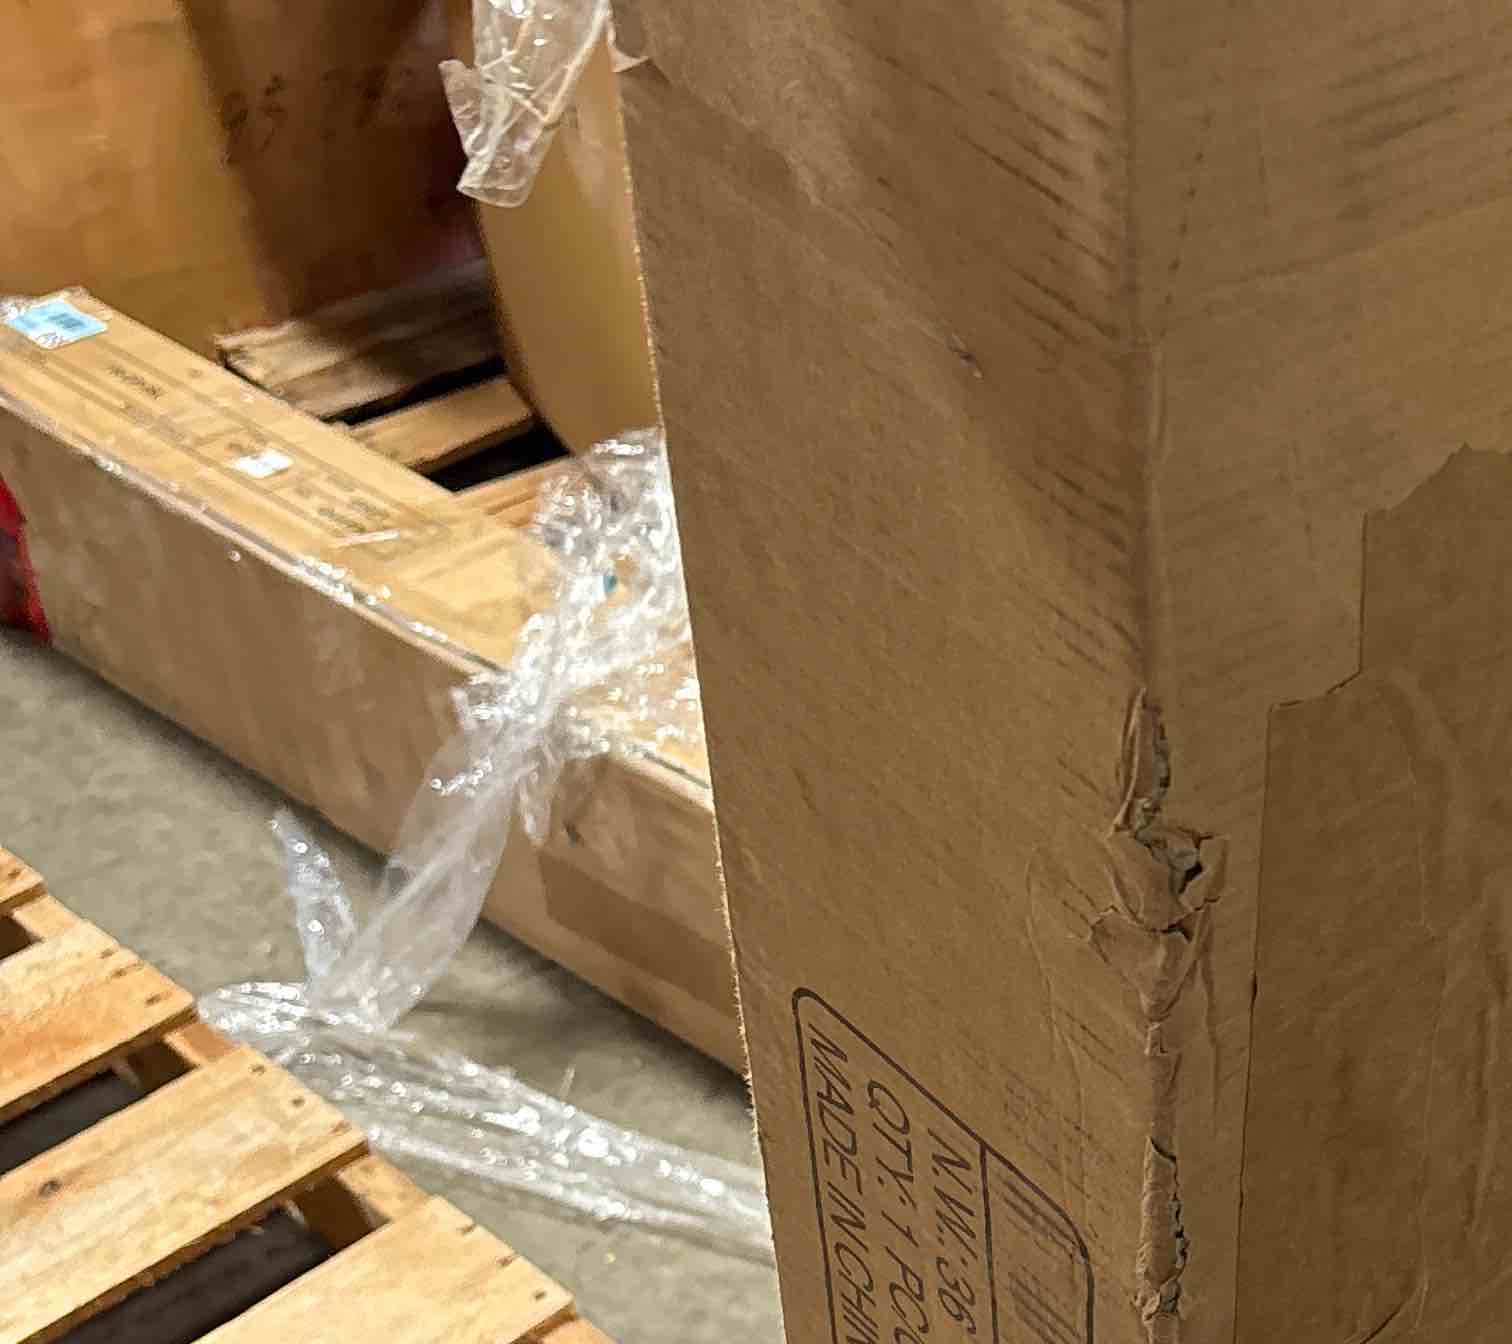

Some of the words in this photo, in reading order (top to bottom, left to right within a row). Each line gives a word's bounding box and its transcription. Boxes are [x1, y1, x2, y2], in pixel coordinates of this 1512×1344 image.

[808, 1023, 864, 1196] MADE
[867, 1079, 918, 1209] QTY:
[827, 1180, 869, 1252] IN
[881, 1210, 919, 1249] 1
